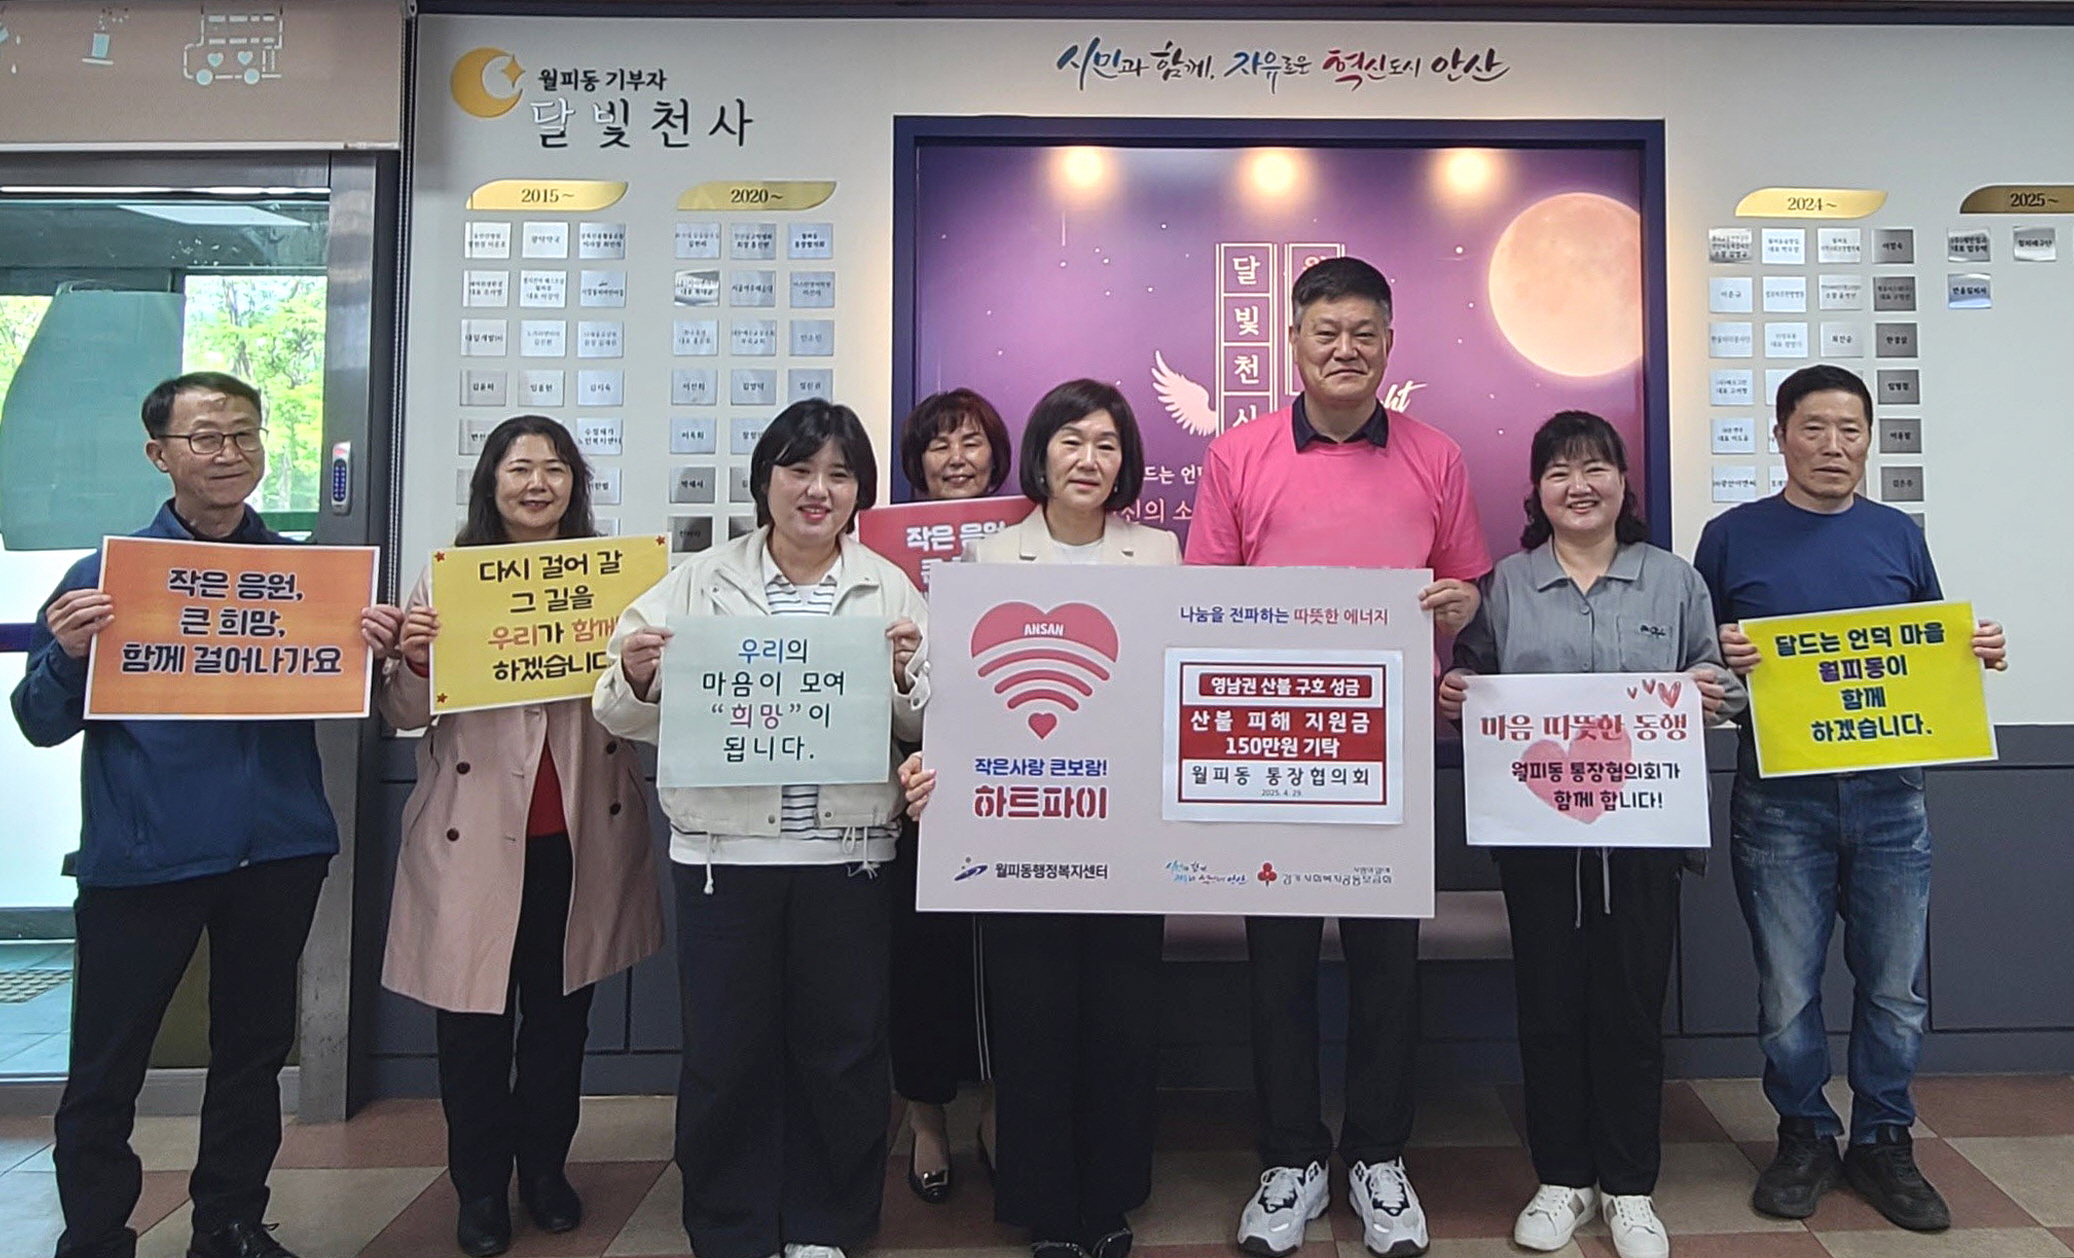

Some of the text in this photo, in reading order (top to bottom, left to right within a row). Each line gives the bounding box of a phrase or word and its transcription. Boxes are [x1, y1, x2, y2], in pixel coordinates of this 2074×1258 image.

[1056, 36, 1149, 91] 시민과
[1223, 51, 1311, 94] 자유로운
[1322, 49, 1421, 91] 혁신도시
[1430, 47, 1510, 83] 안산
[538, 68, 668, 91] 월피동 기부자
[529, 97, 754, 148] 달빛천사
[1143, 465, 1205, 484] 드는 언
[906, 524, 956, 551] 작은
[479, 549, 623, 583] 다시 걸어 갈
[169, 569, 304, 602] 작은 응원,
[510, 585, 594, 613] 그 길을
[181, 607, 286, 638] 큰 희망,
[1180, 606, 1388, 625] 나눔을 전파하는 따뜻한 에너지
[488, 622, 564, 650] 우리가
[1023, 623, 1065, 637] ANSAN
[1775, 622, 1945, 658] 달드는 언덕 마을
[122, 644, 342, 674] 함께 걸어나가요
[738, 638, 808, 664] 우리의
[1818, 655, 1907, 684] 월피동이
[703, 671, 845, 697] 마음이 모여
[1210, 677, 1360, 696] 영남권 산불 구호 성금
[1840, 685, 1886, 710] 함께
[1190, 710, 1371, 734] 산불 피해 지원금
[1480, 714, 1687, 742] 마음 따뜻한 동행
[1811, 713, 1933, 743] 하겠습니다.
[724, 736, 815, 763] 됩니다.
[1225, 737, 1340, 758] 150만원 기탁
[975, 758, 1108, 778] 작은사랑 큰보람!
[1191, 765, 1369, 787] 월피동 통장협의회
[1511, 762, 1680, 784] 월피동 통장협의회가
[974, 785, 1108, 820] 하트파이
[1553, 790, 1663, 811] 함께 합니다!
[995, 863, 1108, 881] 월피동행정복지센터
